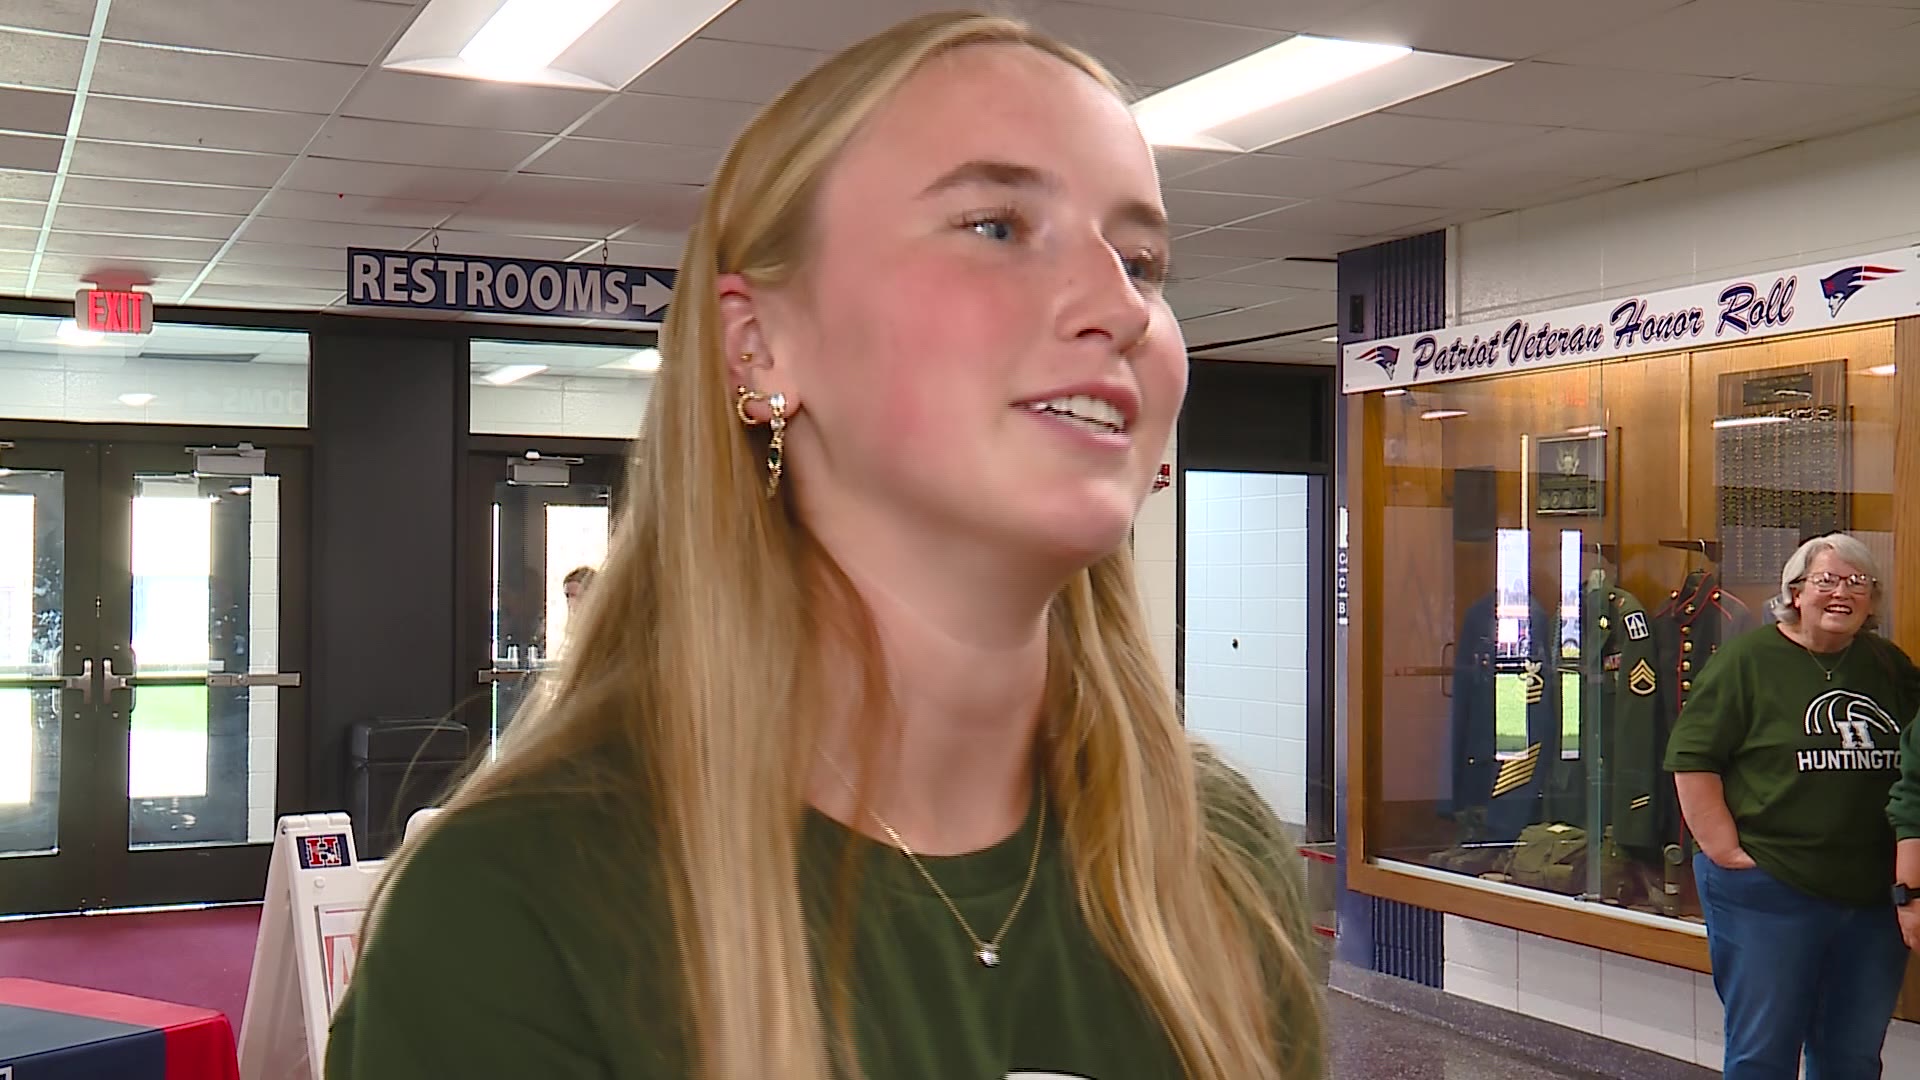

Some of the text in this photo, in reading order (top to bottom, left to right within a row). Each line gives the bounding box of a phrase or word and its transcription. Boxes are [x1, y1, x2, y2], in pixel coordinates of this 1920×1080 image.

[352, 254, 629, 315] RESTROOMS
[88, 291, 145, 333] EXIT
[1412, 274, 1798, 382] Patriot Veteran Honor Roll
[304, 836, 342, 867] H
